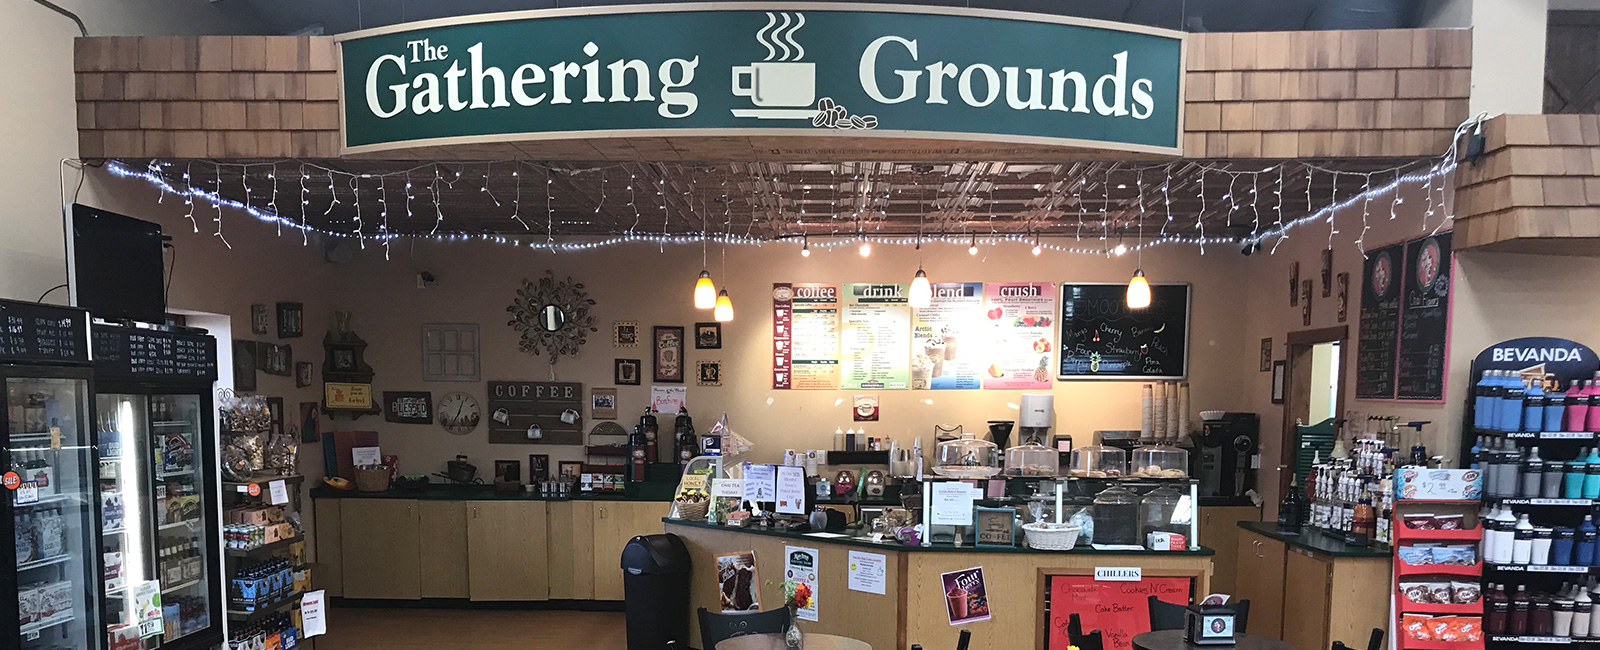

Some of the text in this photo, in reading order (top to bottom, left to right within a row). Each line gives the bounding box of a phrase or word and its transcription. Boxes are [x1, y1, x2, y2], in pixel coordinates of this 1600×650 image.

[407, 38, 449, 63] The
[365, 35, 1154, 120] Gathering Grounds
[797, 285, 836, 298] coffee
[863, 284, 903, 298] drink
[931, 284, 965, 298] lend
[1001, 283, 1038, 297] crush
[1065, 327, 1088, 342] Mango
[1100, 322, 1123, 343] Cherry
[1493, 348, 1582, 362] BEVANDA
[495, 384, 574, 399] COFFEE
[392, 401, 427, 413] BLESSED
[1096, 570, 1140, 578] CHILLERS
[1121, 583, 1149, 594] Cookies
[1160, 584, 1182, 593] Cream
[1095, 603, 1134, 613] Cake Batter
[1104, 629, 1128, 638] Vanilla
